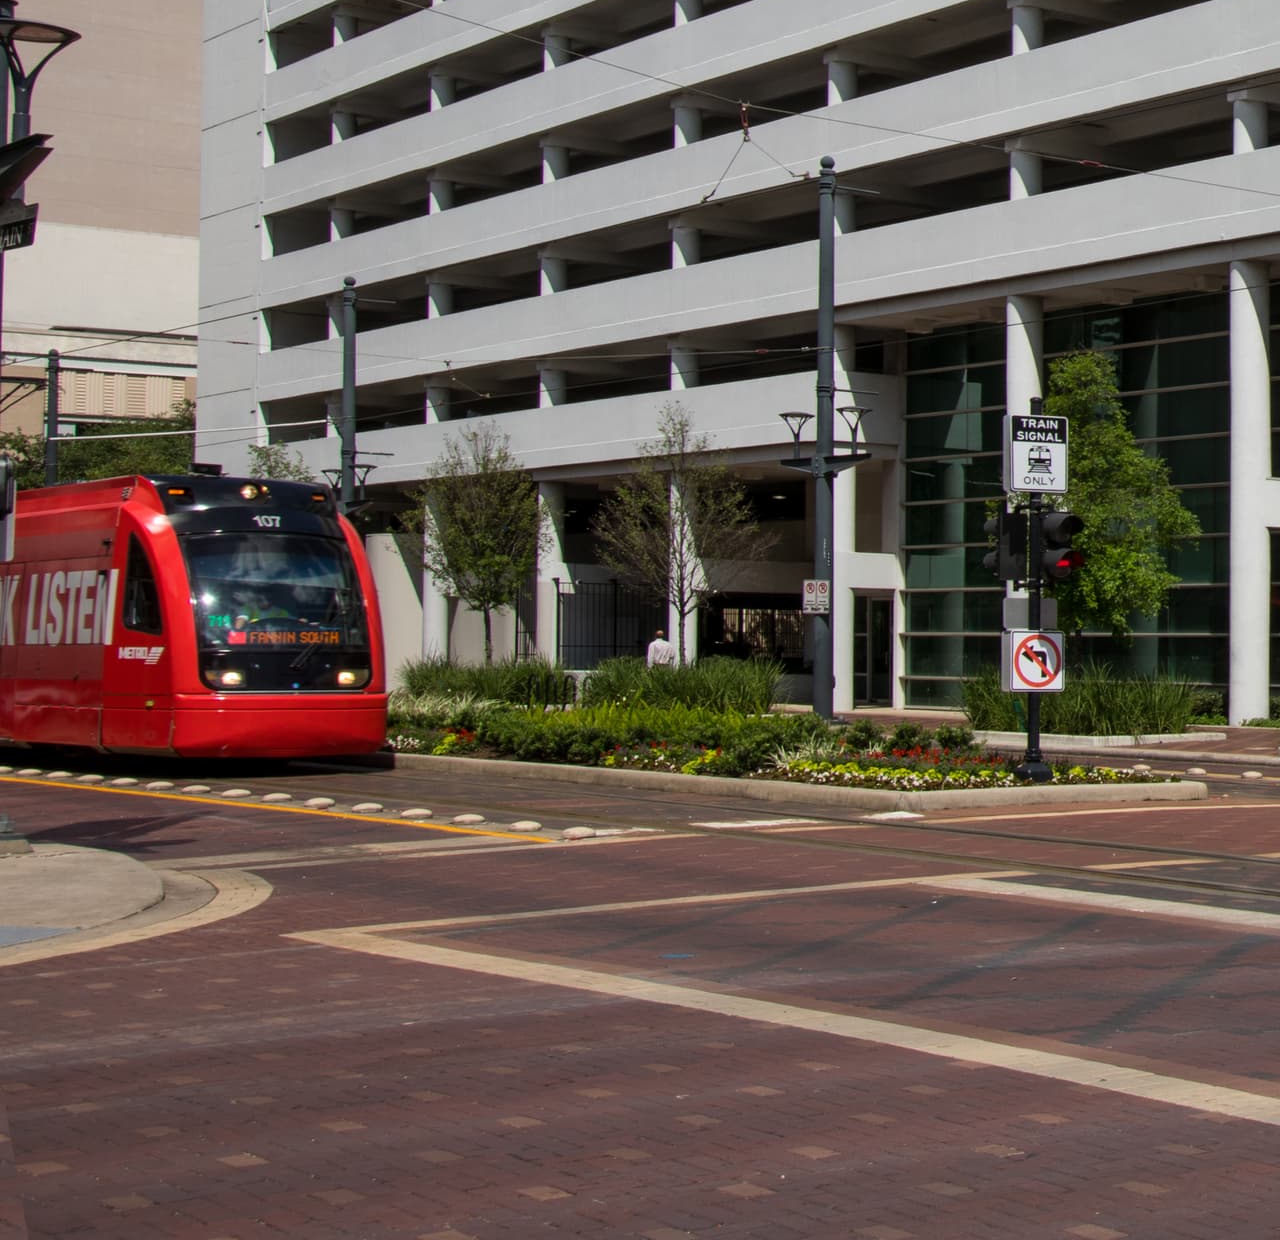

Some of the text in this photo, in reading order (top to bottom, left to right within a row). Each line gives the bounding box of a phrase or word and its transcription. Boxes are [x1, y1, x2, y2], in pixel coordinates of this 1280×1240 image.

[1020, 418, 1058, 429] TRAIN
[1016, 431, 1062, 442] SIGNAL
[1023, 476, 1056, 486] ONLY
[252, 515, 281, 527] 107
[25, 569, 120, 647] LISTEN
[118, 647, 148, 659] METRO
